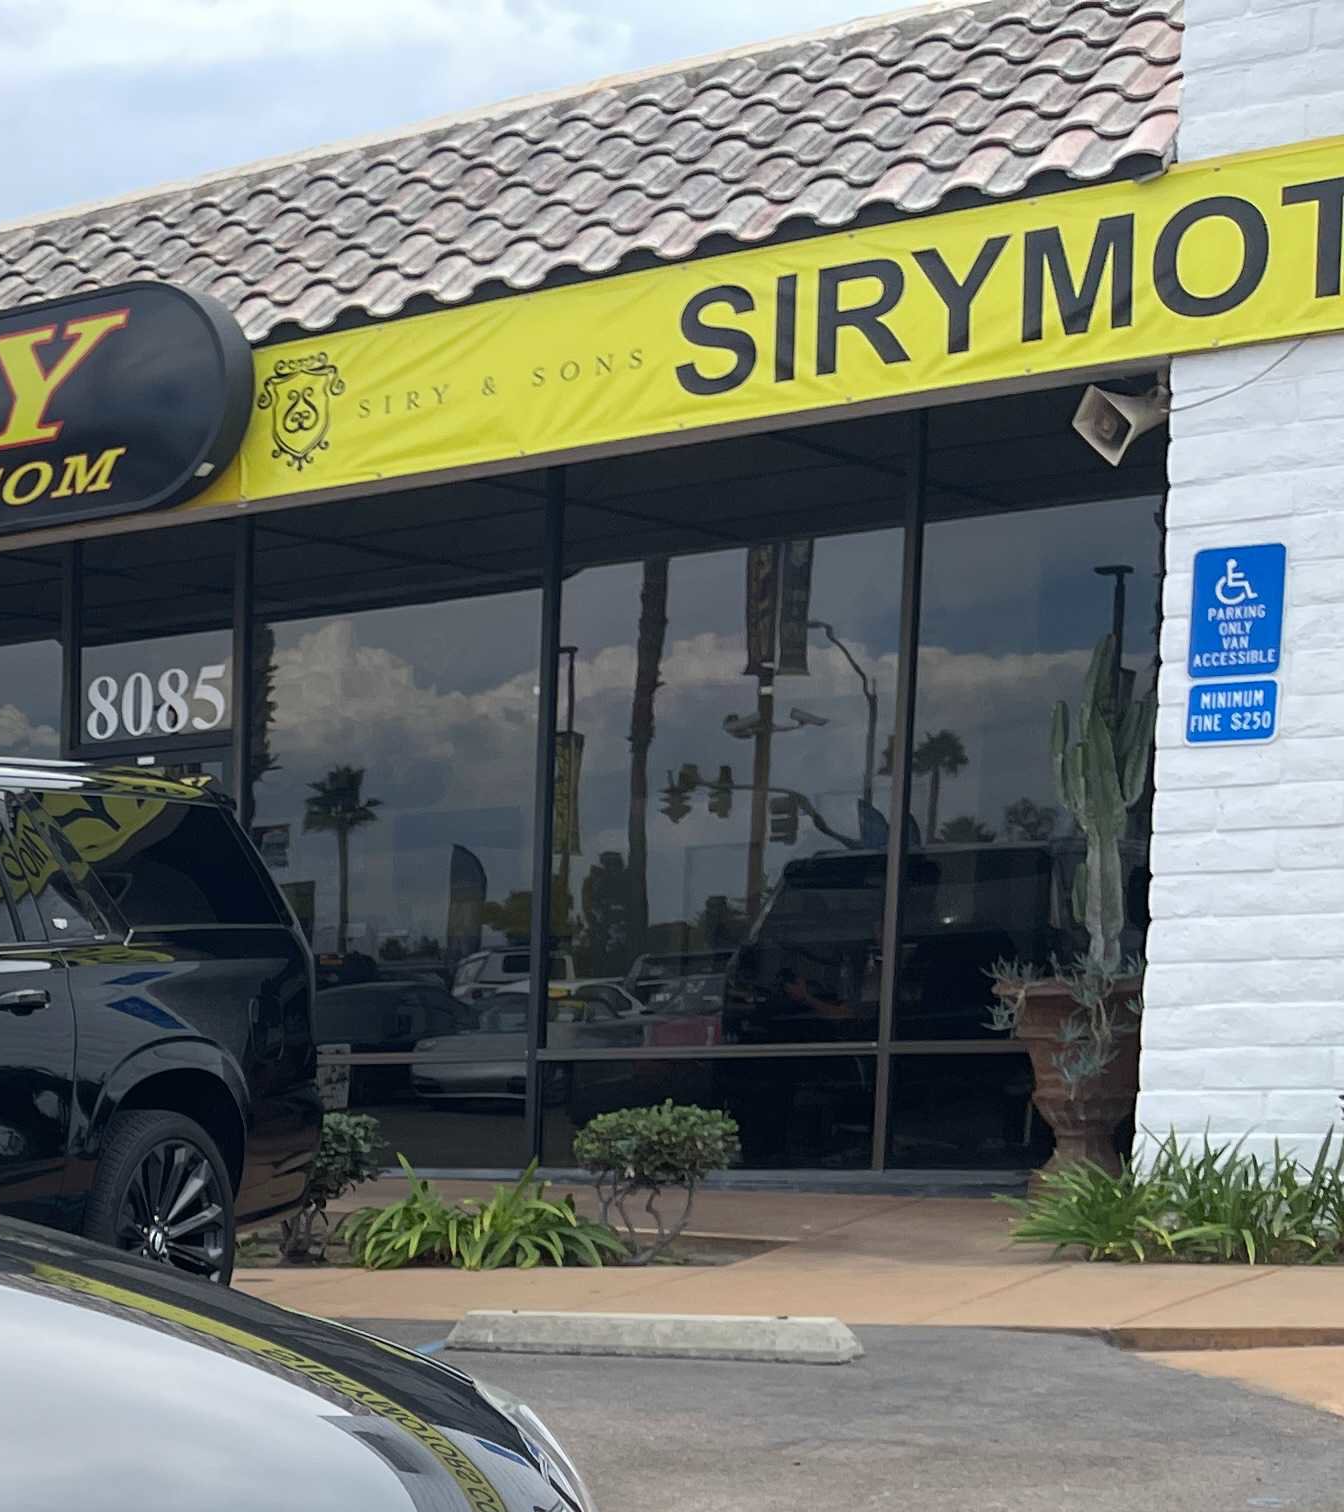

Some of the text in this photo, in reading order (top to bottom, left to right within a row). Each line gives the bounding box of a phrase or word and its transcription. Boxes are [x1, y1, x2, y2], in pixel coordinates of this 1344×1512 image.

[357, 348, 645, 419] SIRY & SONS
[1207, 604, 1267, 622] PARKING
[1218, 621, 1253, 636] ONLY
[1222, 636, 1250, 650] VAN
[1193, 648, 1277, 668] ACCESSIBLE
[86, 663, 226, 740] 8085
[1200, 689, 1265, 710] MINIMUM
[1190, 710, 1272, 733] FINE $250
